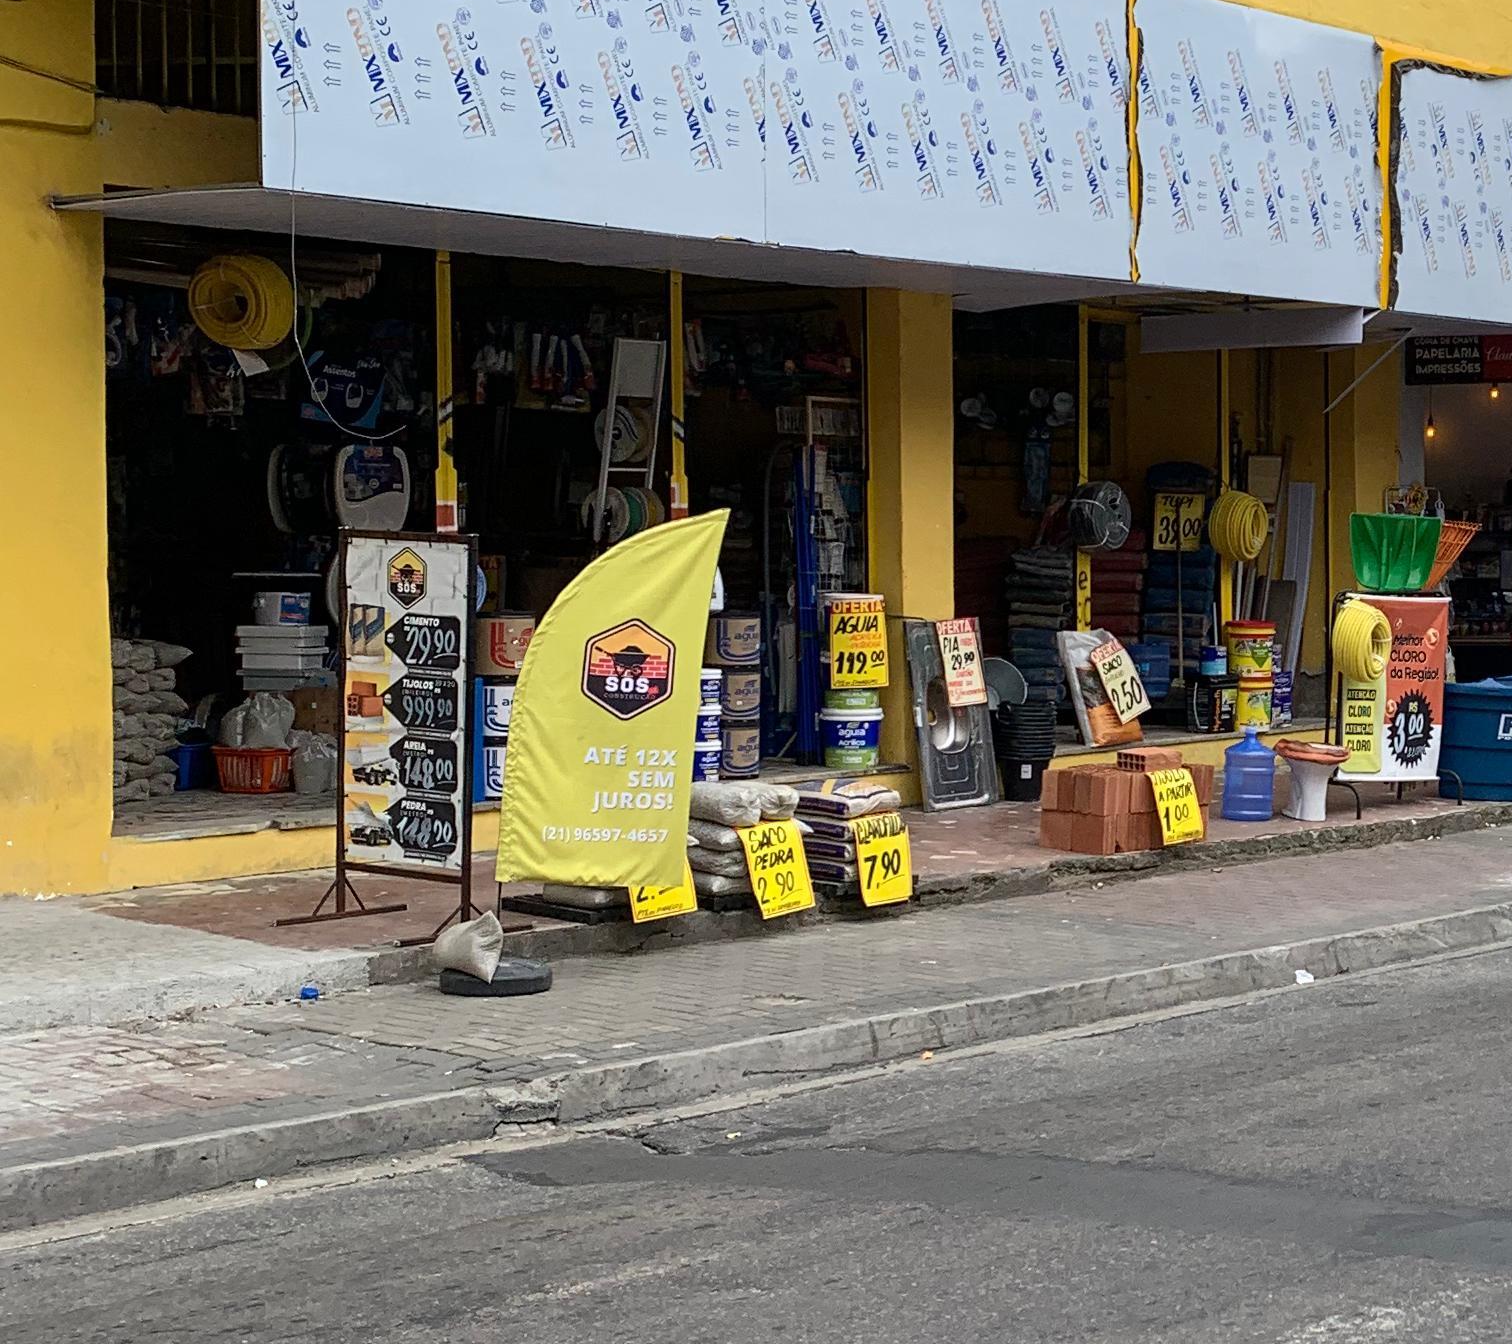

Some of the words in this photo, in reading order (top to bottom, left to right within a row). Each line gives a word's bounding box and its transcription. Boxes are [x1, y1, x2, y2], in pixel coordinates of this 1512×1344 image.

[1415, 347, 1480, 359] PAPELARIA
[1416, 360, 1481, 374] IMPRESSÕES
[397, 582, 417, 594] SOS
[403, 615, 440, 627] CIMENTO
[935, 619, 973, 635] OFERTA
[943, 636, 959, 655] PIA
[1392, 634, 1424, 647] Melhor
[1390, 650, 1427, 664] CLORO
[1102, 655, 1123, 676] SACO
[1390, 668, 1403, 679] da
[402, 678, 434, 691] TIJOLOS
[605, 676, 650, 693] SOS
[1348, 705, 1372, 718] CLORO
[403, 740, 427, 752] AREIA
[584, 744, 629, 767] ATÉ
[636, 750, 677, 767] 12X
[628, 771, 675, 789] SEM
[400, 799, 427, 811] PEDRA
[592, 791, 674, 813] JUROS!
[542, 826, 570, 843] (21)
[574, 827, 669, 843] 96597-4657
[749, 826, 787, 854] SACO
[754, 847, 795, 872] PEDRA
